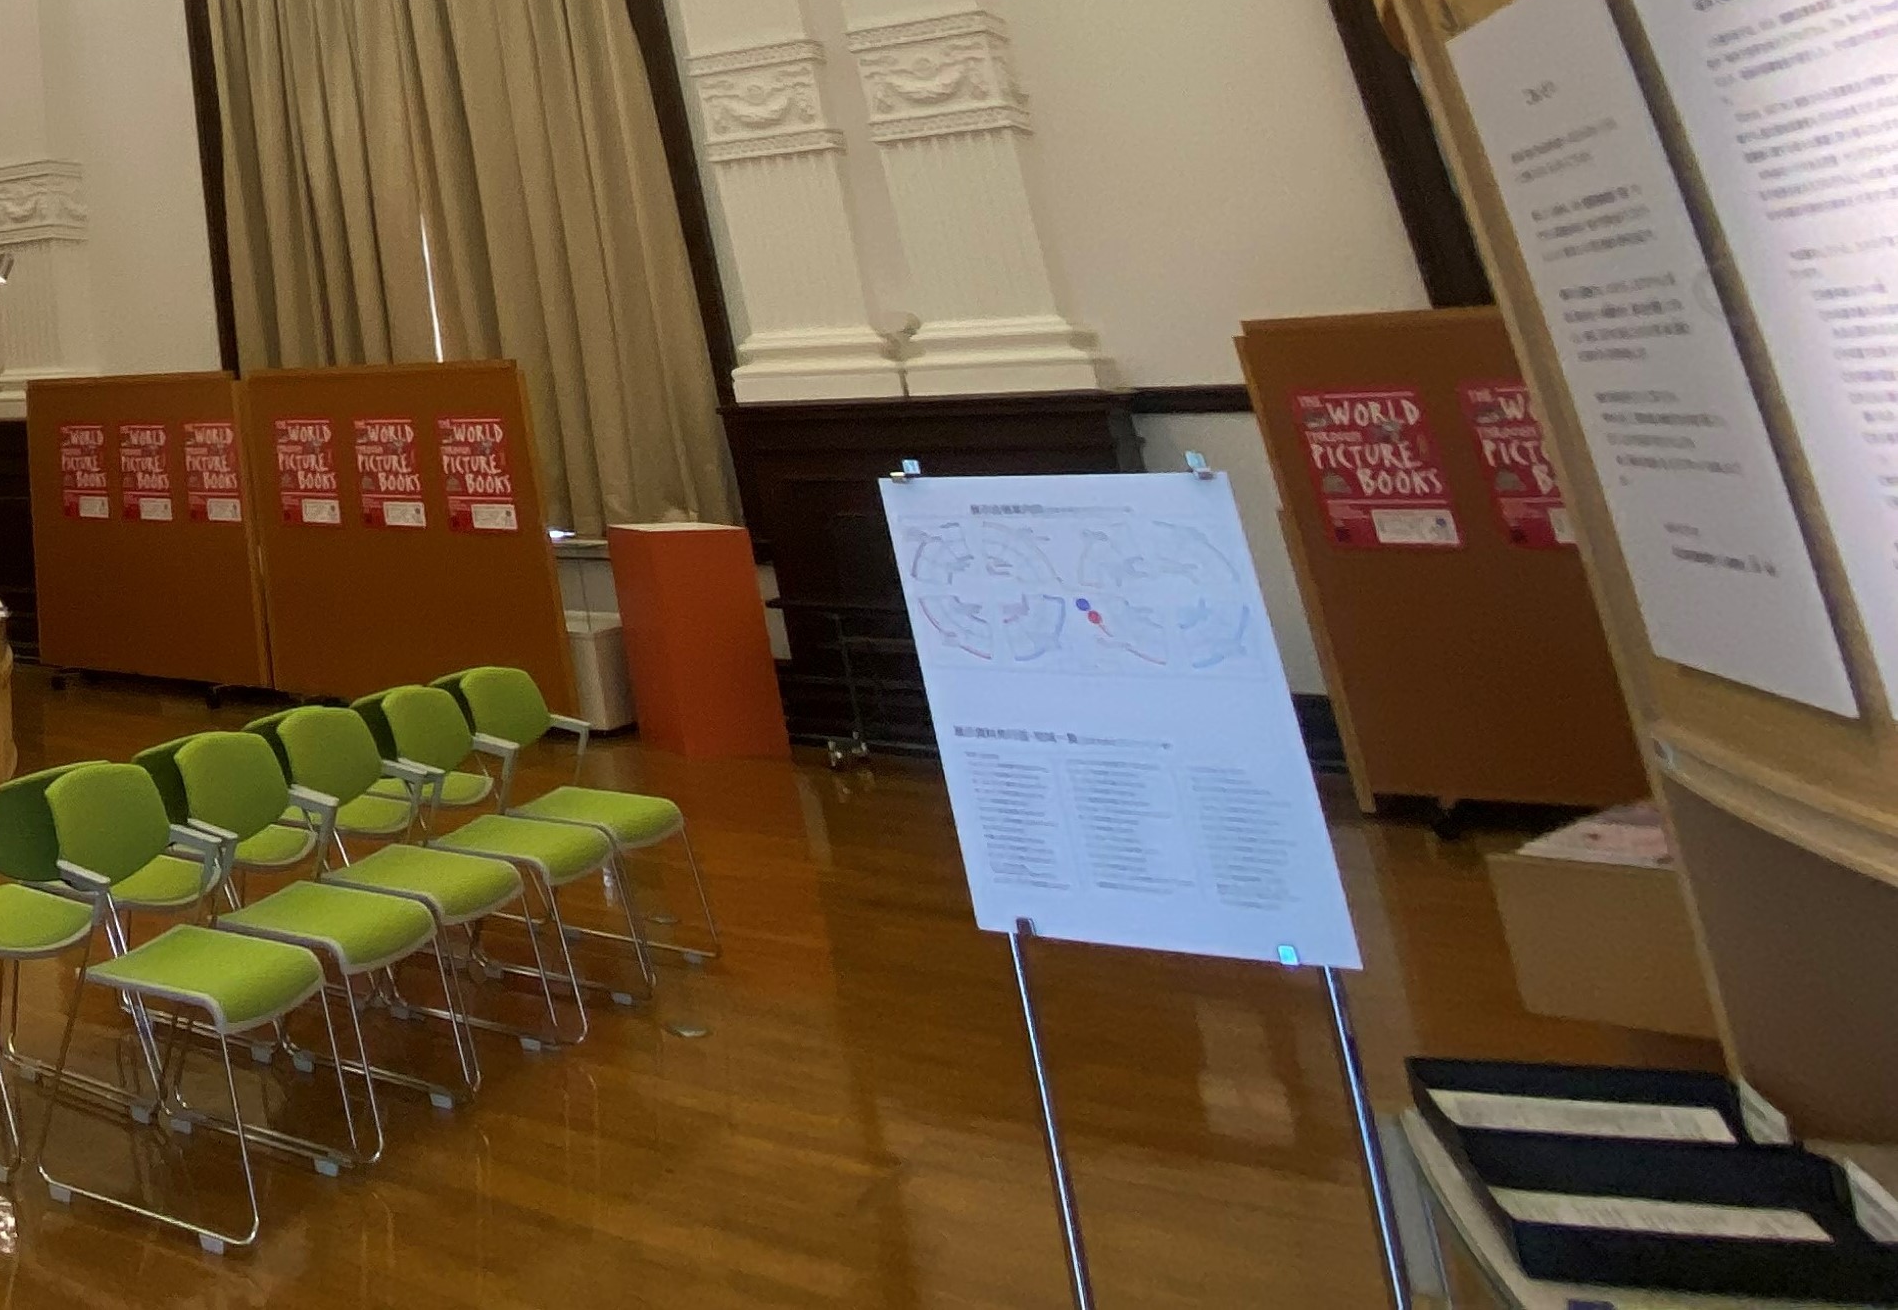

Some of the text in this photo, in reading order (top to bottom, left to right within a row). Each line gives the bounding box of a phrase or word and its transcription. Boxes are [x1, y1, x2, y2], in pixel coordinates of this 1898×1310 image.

[1325, 399, 1421, 426] WORLD
[287, 424, 332, 443] WORLD
[367, 424, 414, 443] WORLD
[453, 423, 503, 443] WORLD
[278, 453, 329, 472] PICTURE
[357, 453, 412, 473] PICTURE
[1311, 441, 1423, 469] PICTURE
[1482, 439, 1540, 467] PICT
[442, 454, 502, 475] PICTURE
[297, 470, 337, 489] BOOKS
[378, 472, 420, 492] BOOKS
[465, 473, 511, 494] BOOKS
[1356, 467, 1443, 496] BOOKS
